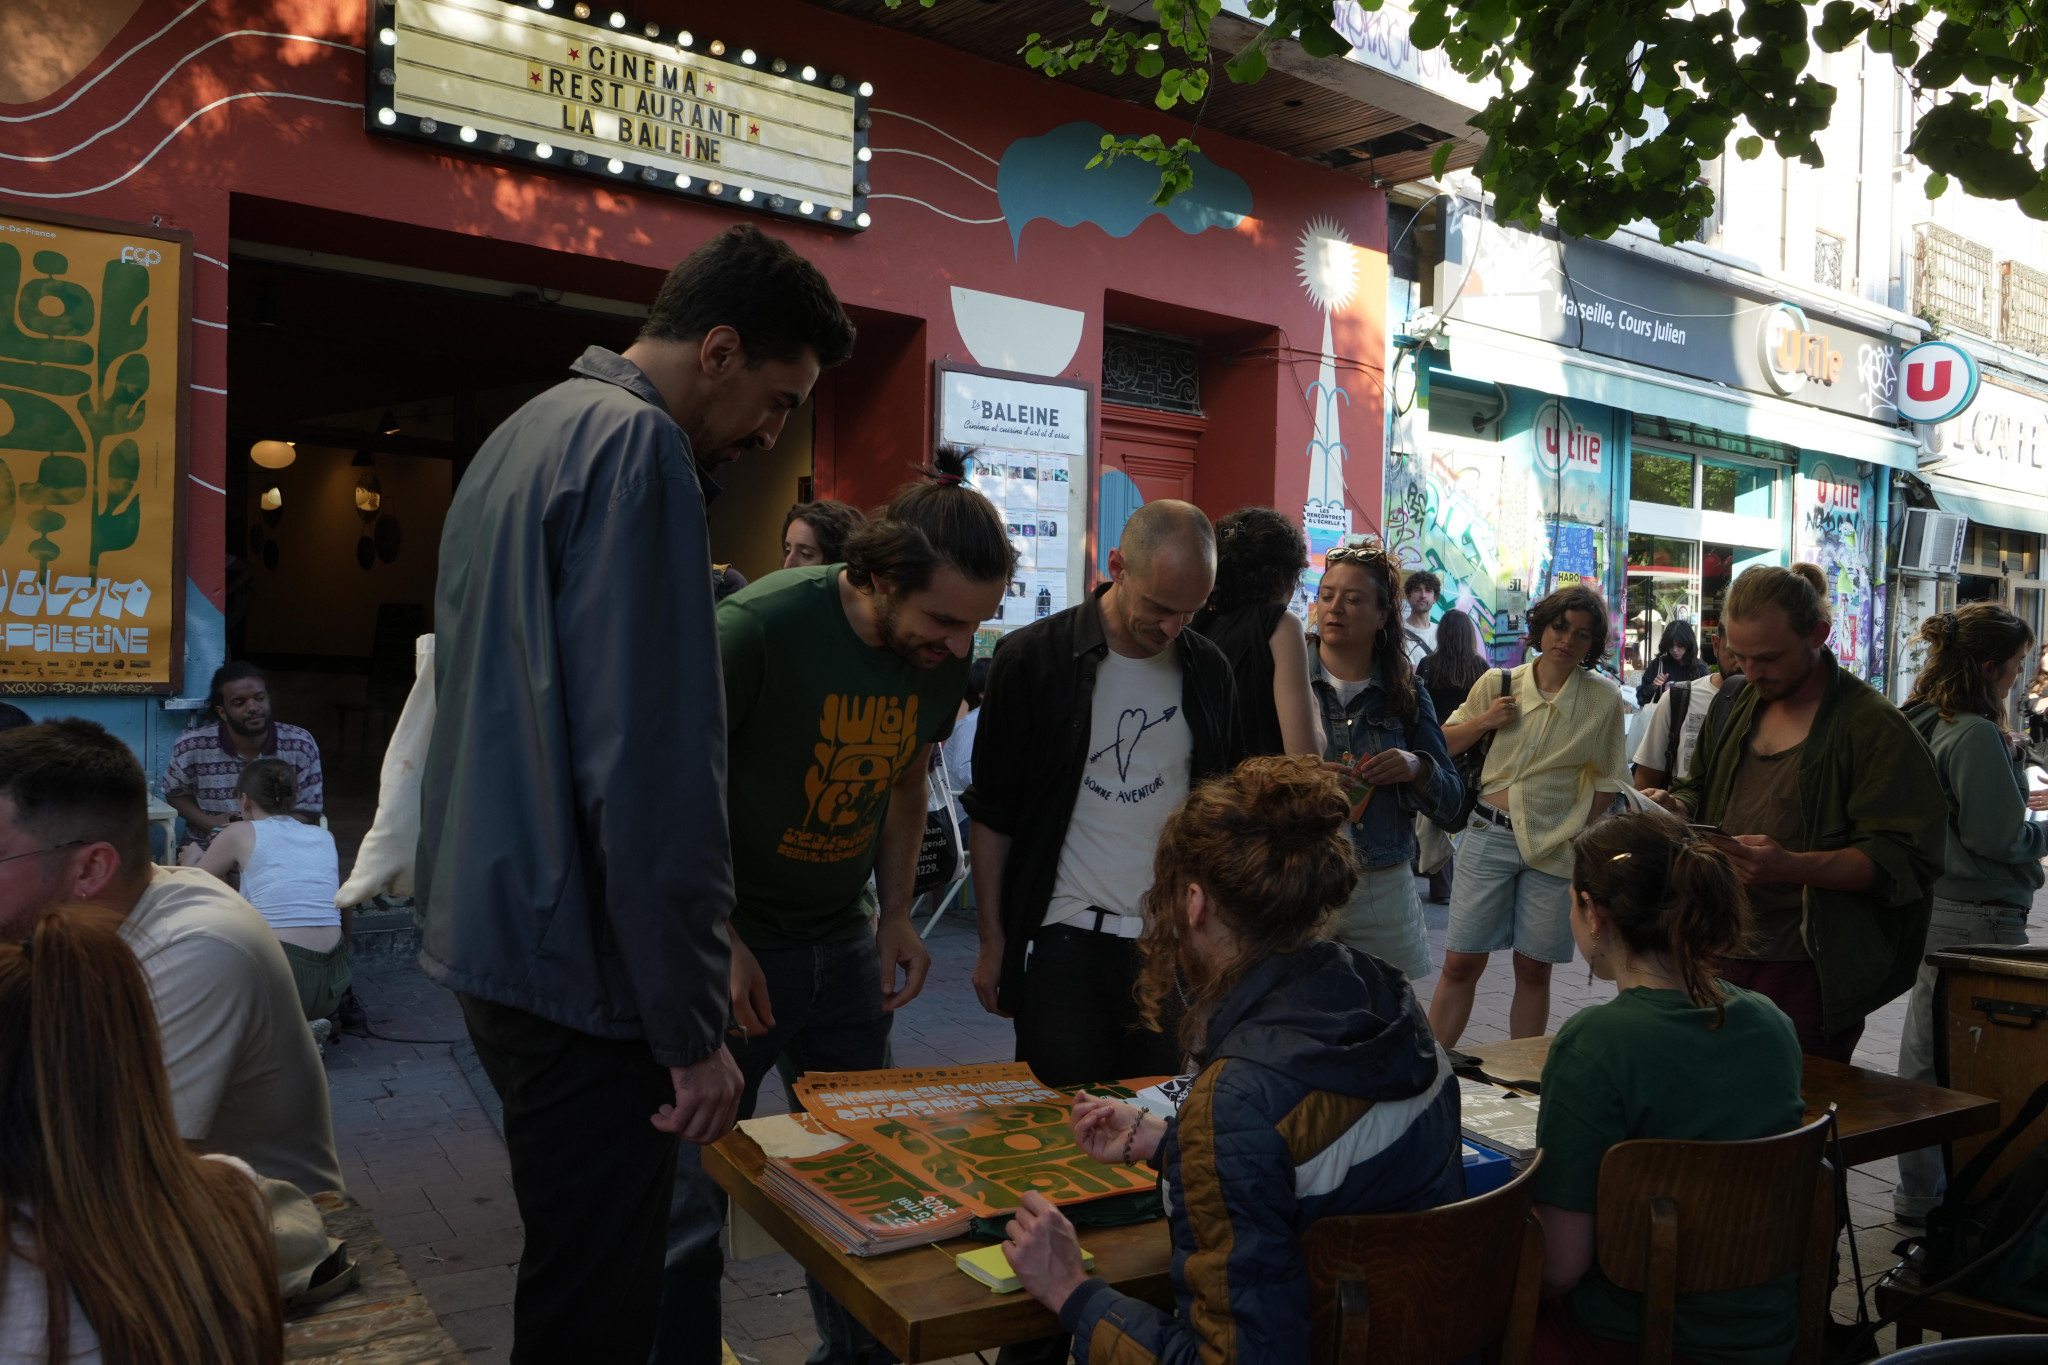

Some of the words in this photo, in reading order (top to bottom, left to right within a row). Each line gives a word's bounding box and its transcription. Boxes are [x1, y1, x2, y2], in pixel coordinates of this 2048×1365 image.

[562, 106, 595, 135] LA
[1555, 292, 1615, 329] Marseille,
[1618, 310, 1653, 337] Cours
[1653, 320, 1686, 345] Julien
[1907, 360, 1952, 402] U
[971, 399, 981, 411] La
[981, 400, 1059, 427] BALEINE
[963, 420, 990, 432] Cinéma
[991, 424, 999, 432] et
[999, 425, 1023, 436] cuisine
[1041, 429, 1048, 438] et
[1306, 512, 1342, 521] RENCONTRES
[1508, 579, 1520, 591] 61
[919, 853, 938, 863] ince
[917, 1196, 957, 1218] 2025
